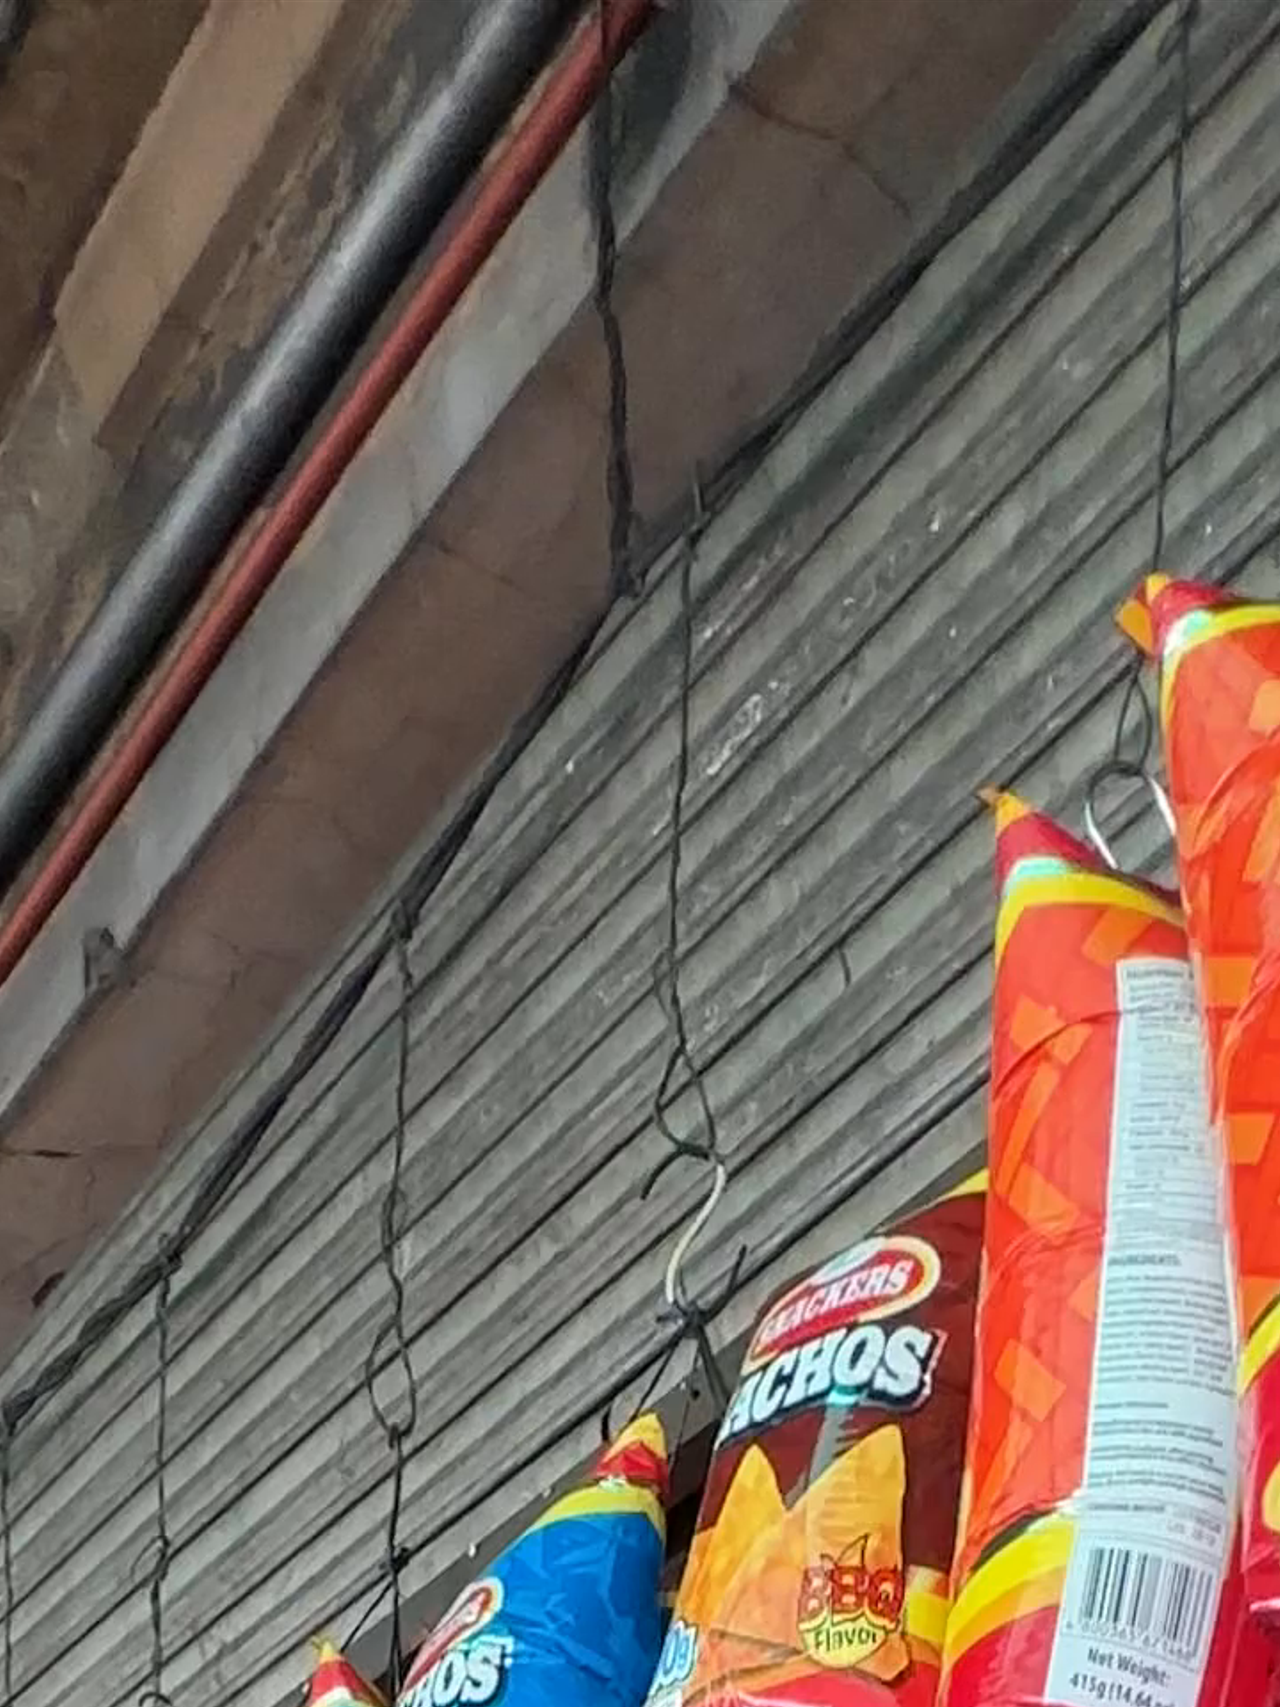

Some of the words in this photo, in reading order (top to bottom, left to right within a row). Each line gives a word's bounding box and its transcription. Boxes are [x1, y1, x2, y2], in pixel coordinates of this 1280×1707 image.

[798, 1564, 906, 1630] BBQ
[812, 1630, 879, 1652] Flavor
[1087, 1648, 1113, 1664] Net
[1070, 1672, 1107, 1699] 415g
